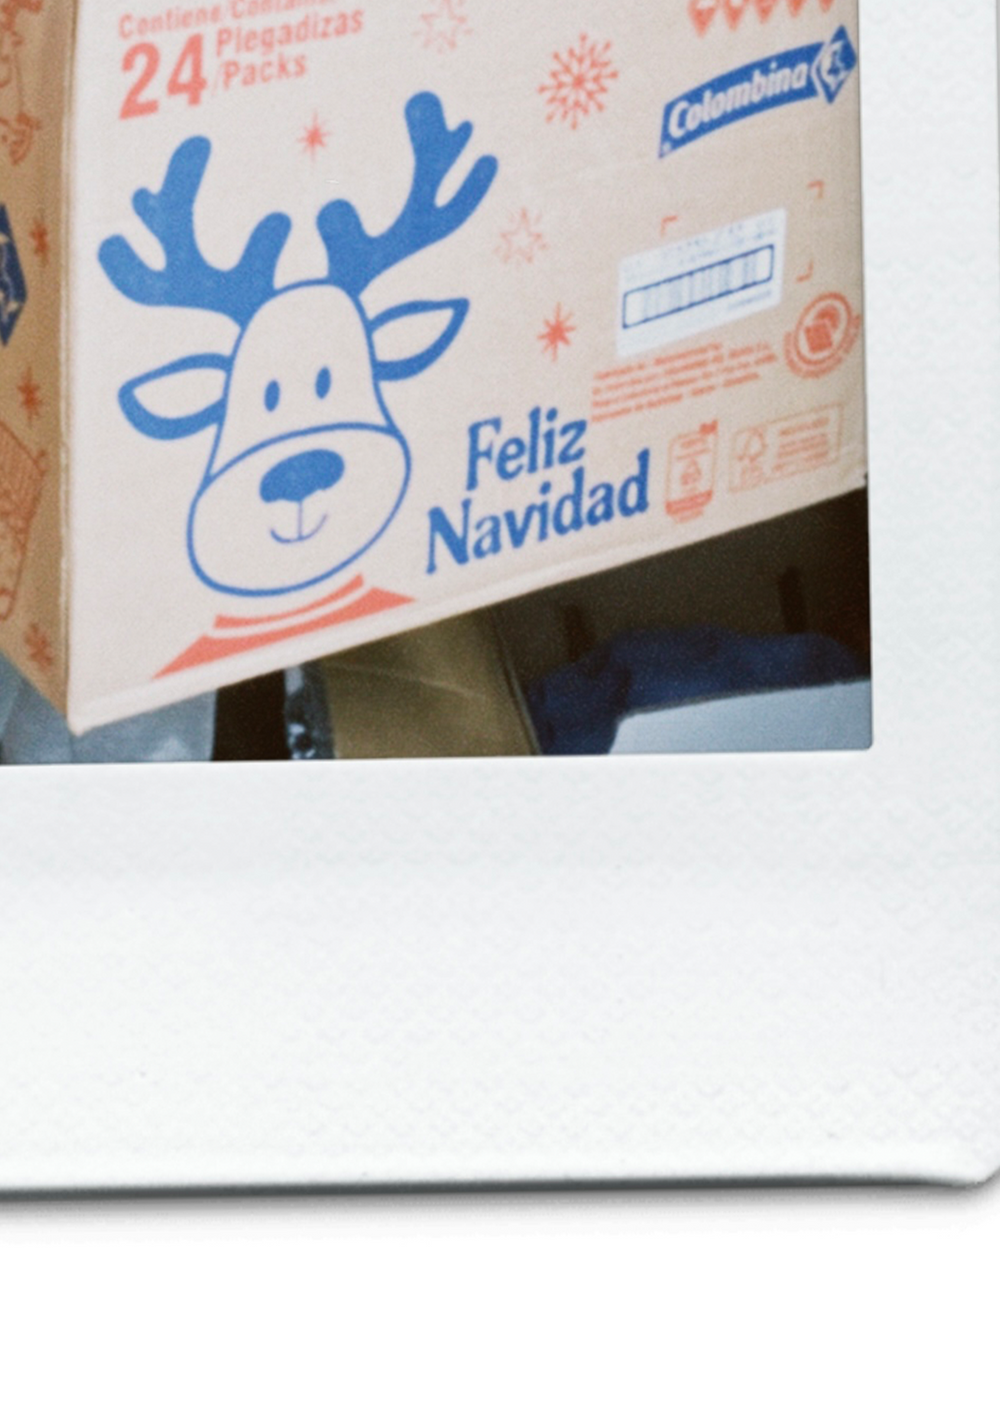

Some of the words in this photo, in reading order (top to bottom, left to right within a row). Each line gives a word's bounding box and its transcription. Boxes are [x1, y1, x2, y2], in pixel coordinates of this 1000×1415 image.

[216, 9, 365, 58] Plegadizas
[118, 33, 208, 121] 24
[668, 61, 809, 139] Colombina
[466, 406, 588, 492] Feliz
[425, 448, 651, 576] Navidad
